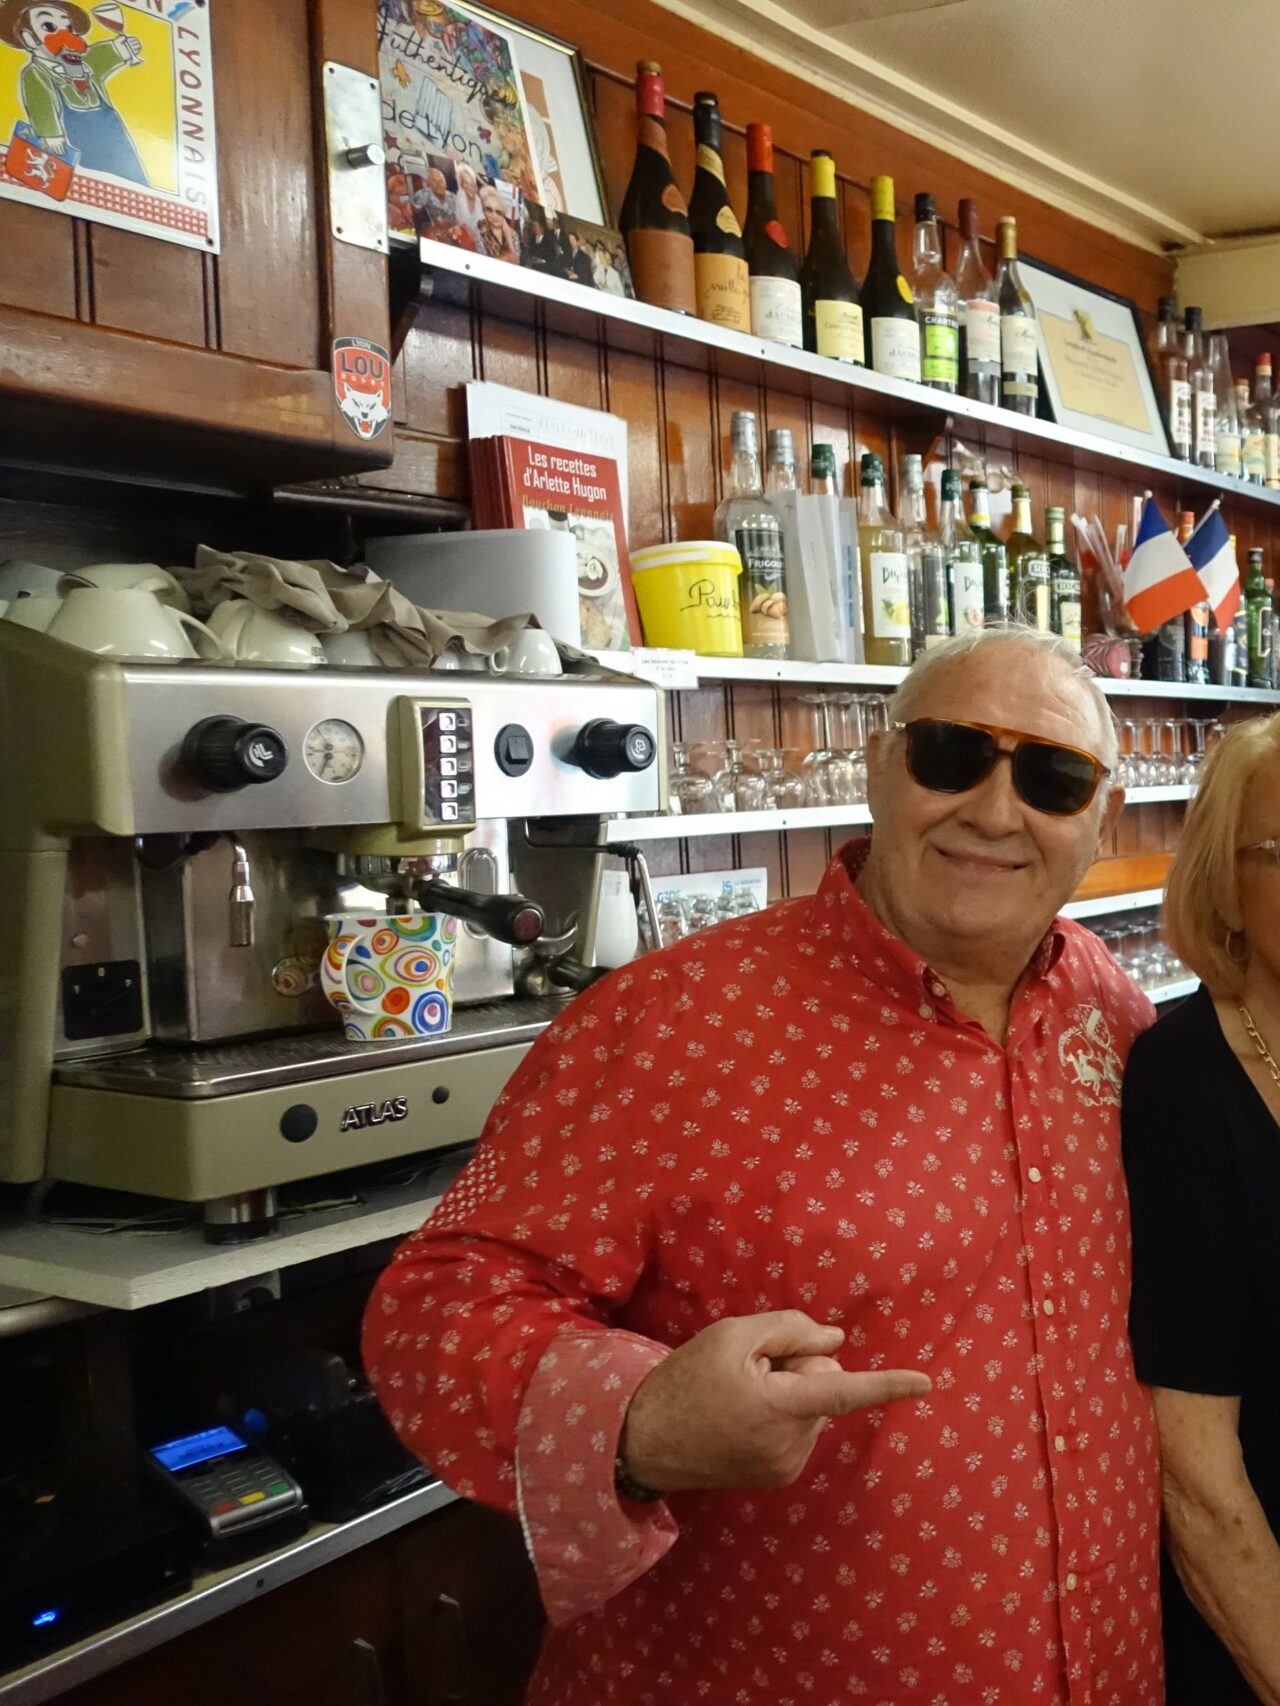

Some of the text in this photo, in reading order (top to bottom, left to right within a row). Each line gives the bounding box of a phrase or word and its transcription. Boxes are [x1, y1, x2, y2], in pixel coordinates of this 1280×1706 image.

[178, 25, 208, 206] LYONNAIS
[382, 100, 415, 129] de
[341, 351, 384, 379] LOU
[527, 445, 598, 478] Les recettes
[523, 467, 607, 502] d'Arlette Hugon
[340, 1096, 408, 1132] ATLAS
